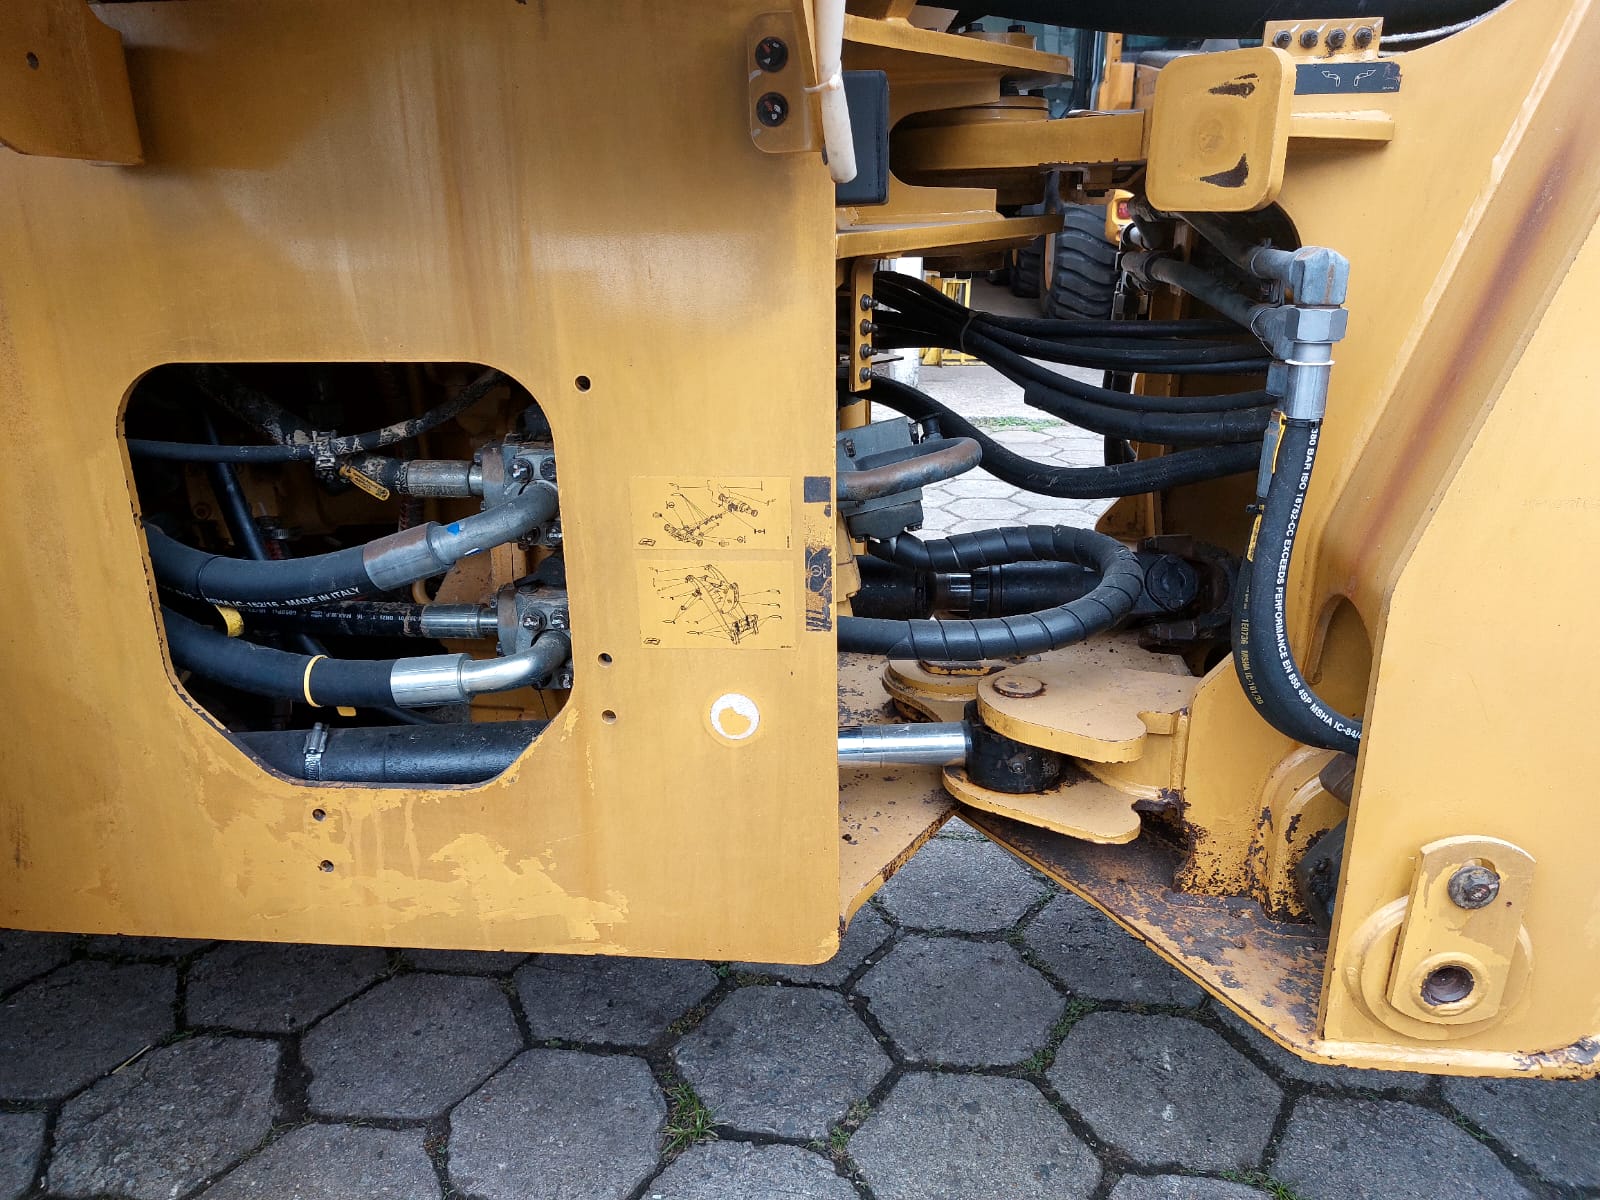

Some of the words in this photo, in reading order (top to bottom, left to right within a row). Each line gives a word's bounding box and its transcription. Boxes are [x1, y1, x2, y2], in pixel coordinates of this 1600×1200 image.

[1308, 428, 1319, 445] 380
[1303, 448, 1315, 470] BAR
[1298, 472, 1309, 490] ISO
[1286, 493, 1304, 536] 18752-CC
[1276, 539, 1292, 585] EXCEEDS
[286, 595, 318, 606] MADE
[317, 592, 331, 603] IN
[330, 586, 361, 601] ITALY
[1274, 586, 1288, 659] PERFORMANCE
[1240, 650, 1250, 671] MSHA
[1282, 659, 1293, 673] EN
[1297, 689, 1312, 704] 4SP
[1309, 703, 1334, 726] MSHA
